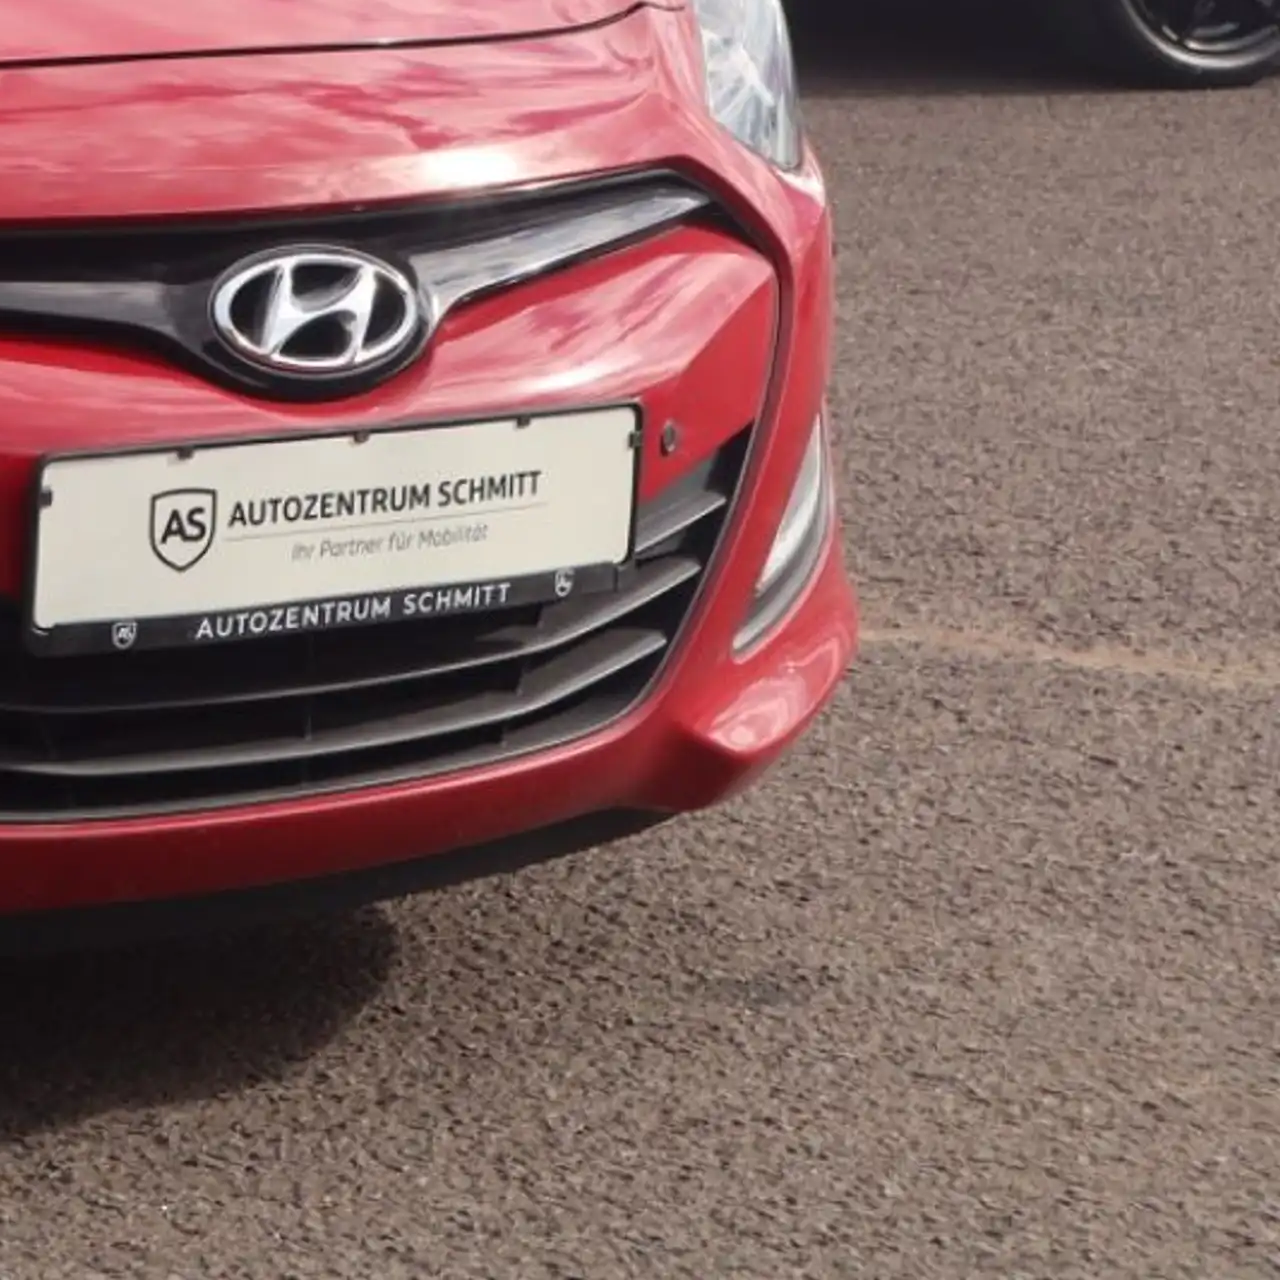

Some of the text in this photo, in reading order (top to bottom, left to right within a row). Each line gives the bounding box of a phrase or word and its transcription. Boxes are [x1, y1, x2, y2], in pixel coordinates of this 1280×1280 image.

[227, 470, 542, 528] AUTOZENTRUM SCHMITT
[160, 506, 207, 545] AS
[291, 522, 488, 562] Ihr Partner für Mobilität
[195, 582, 511, 640] AUTOZENTRUM SCHMITT
